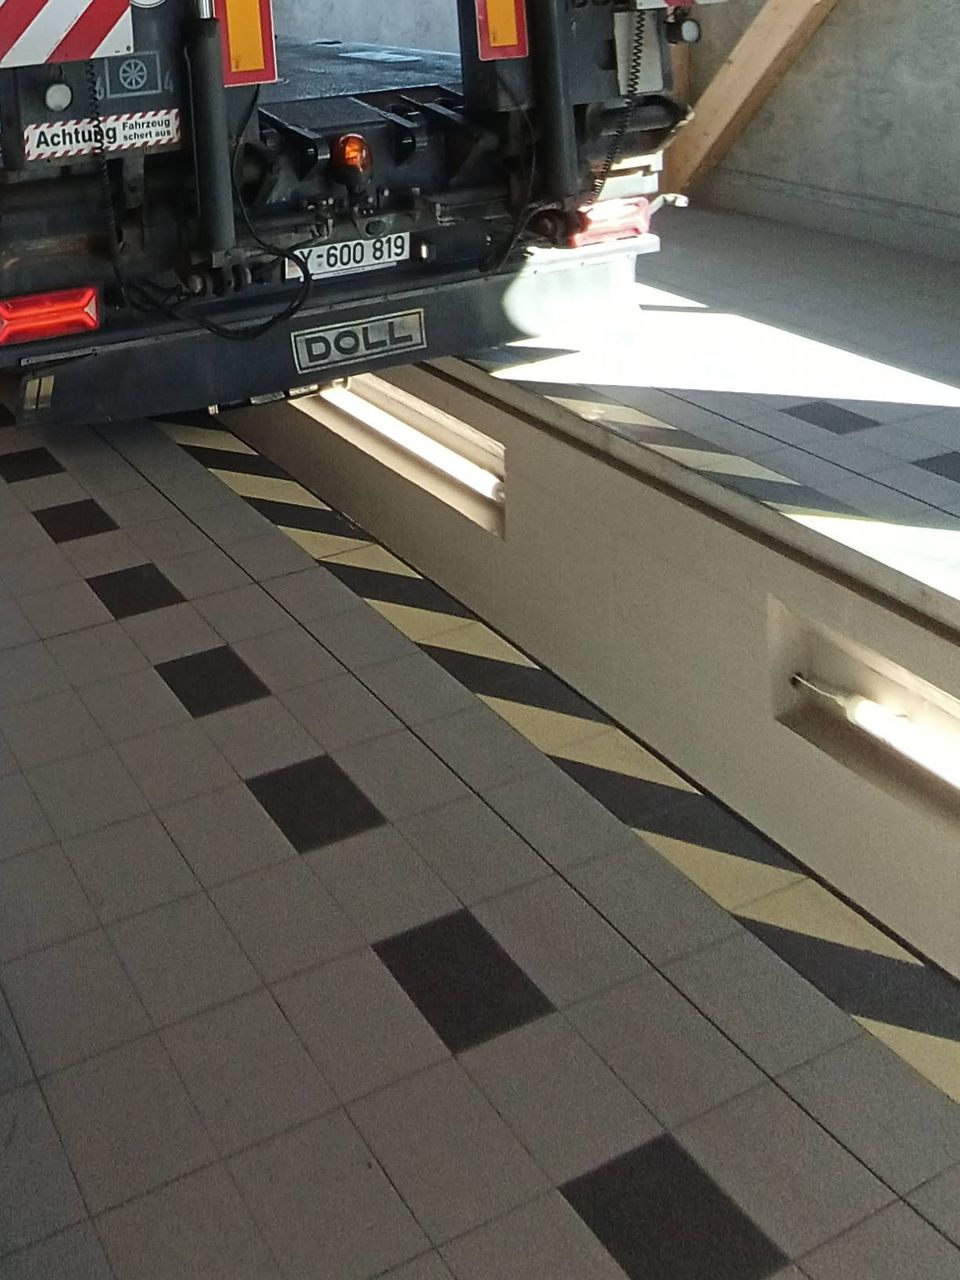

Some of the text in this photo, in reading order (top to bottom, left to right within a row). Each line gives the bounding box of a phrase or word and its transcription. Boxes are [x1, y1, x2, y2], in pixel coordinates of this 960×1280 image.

[122, 119, 171, 132] Fahrzeug
[123, 129, 172, 141] schert aus
[299, 235, 405, 268] Y-600 819
[305, 321, 414, 364] DOLL
